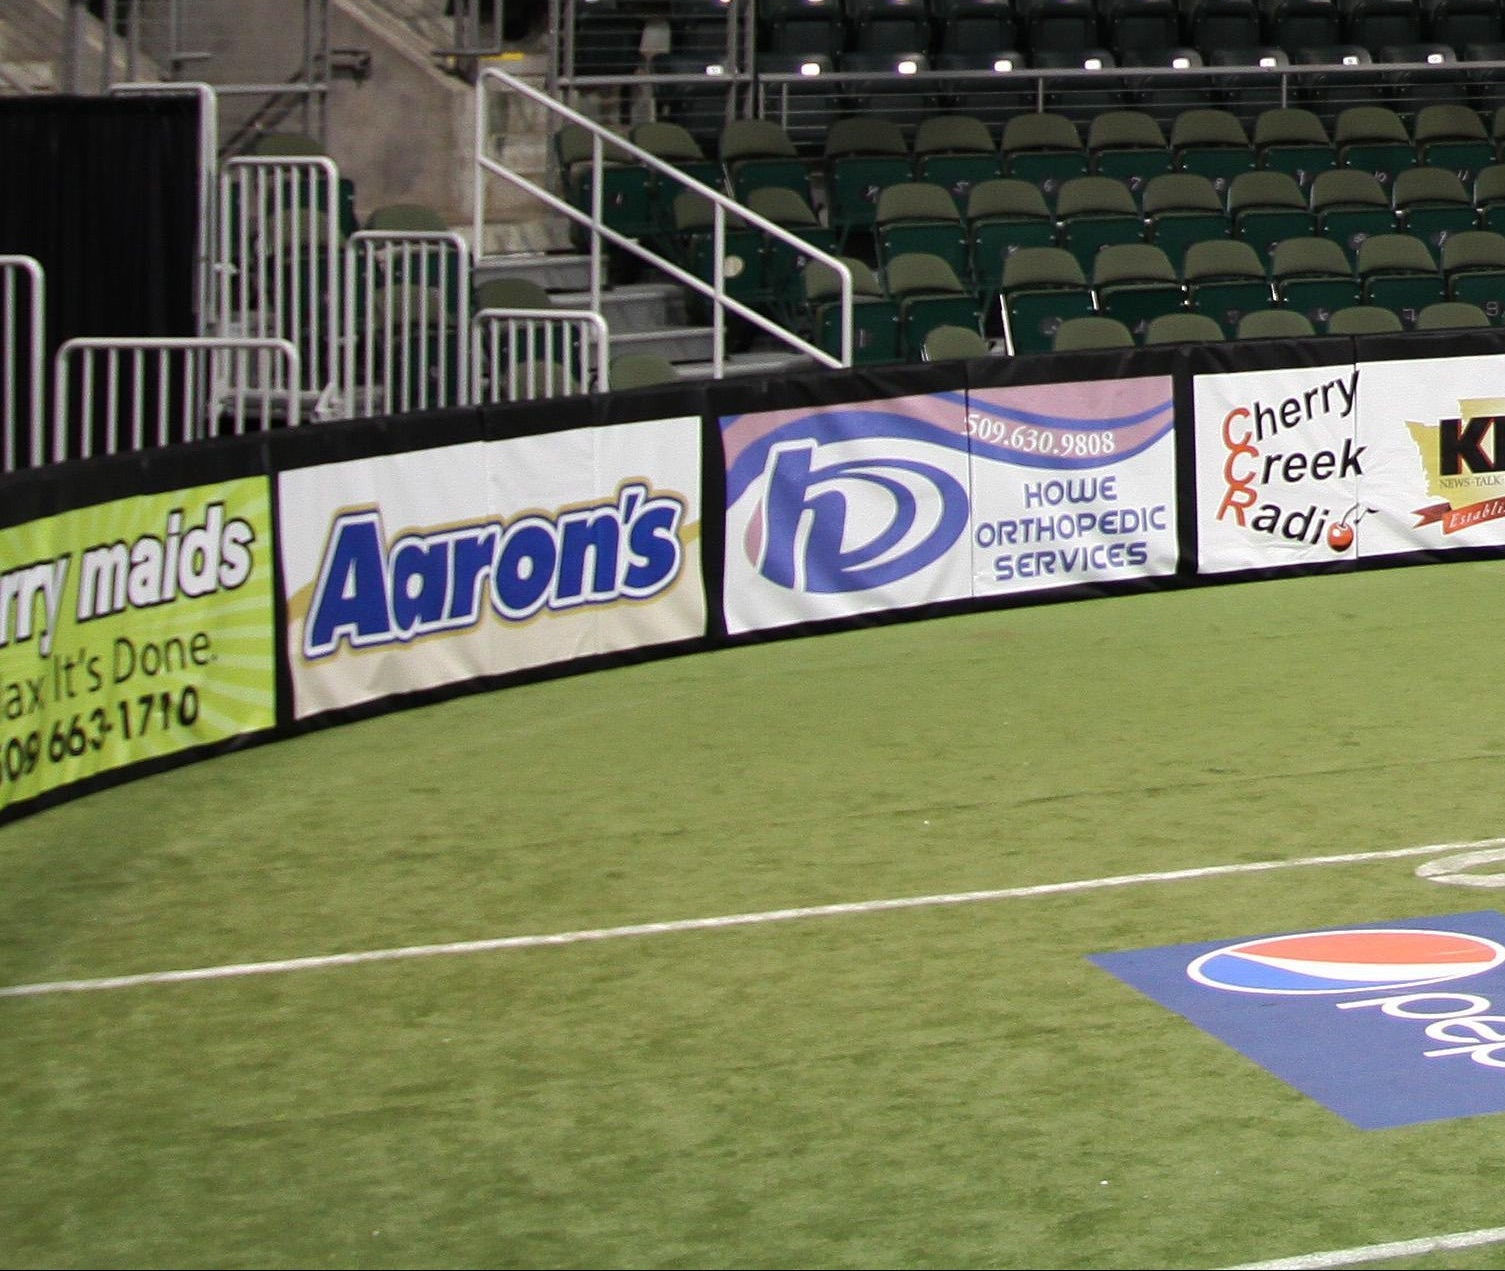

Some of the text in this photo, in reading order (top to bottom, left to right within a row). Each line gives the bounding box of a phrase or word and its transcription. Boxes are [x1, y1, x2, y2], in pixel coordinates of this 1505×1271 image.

[965, 414, 1116, 457] 509.630.9808
[1222, 370, 1359, 452] Cherry
[1223, 438, 1369, 488] Creek
[1440, 477, 1470, 489] NEWS
[1475, 475, 1501, 486] TALK
[1024, 475, 1118, 509] HOWE
[975, 505, 1167, 549] ORTHOPEDIC
[0, 502, 257, 659] rry maids
[303, 482, 685, 662] Aaron's
[993, 541, 1148, 582] SERVICES
[53, 647, 103, 701] It's
[113, 632, 218, 684] Done.
[48, 684, 199, 763] 663-1710
